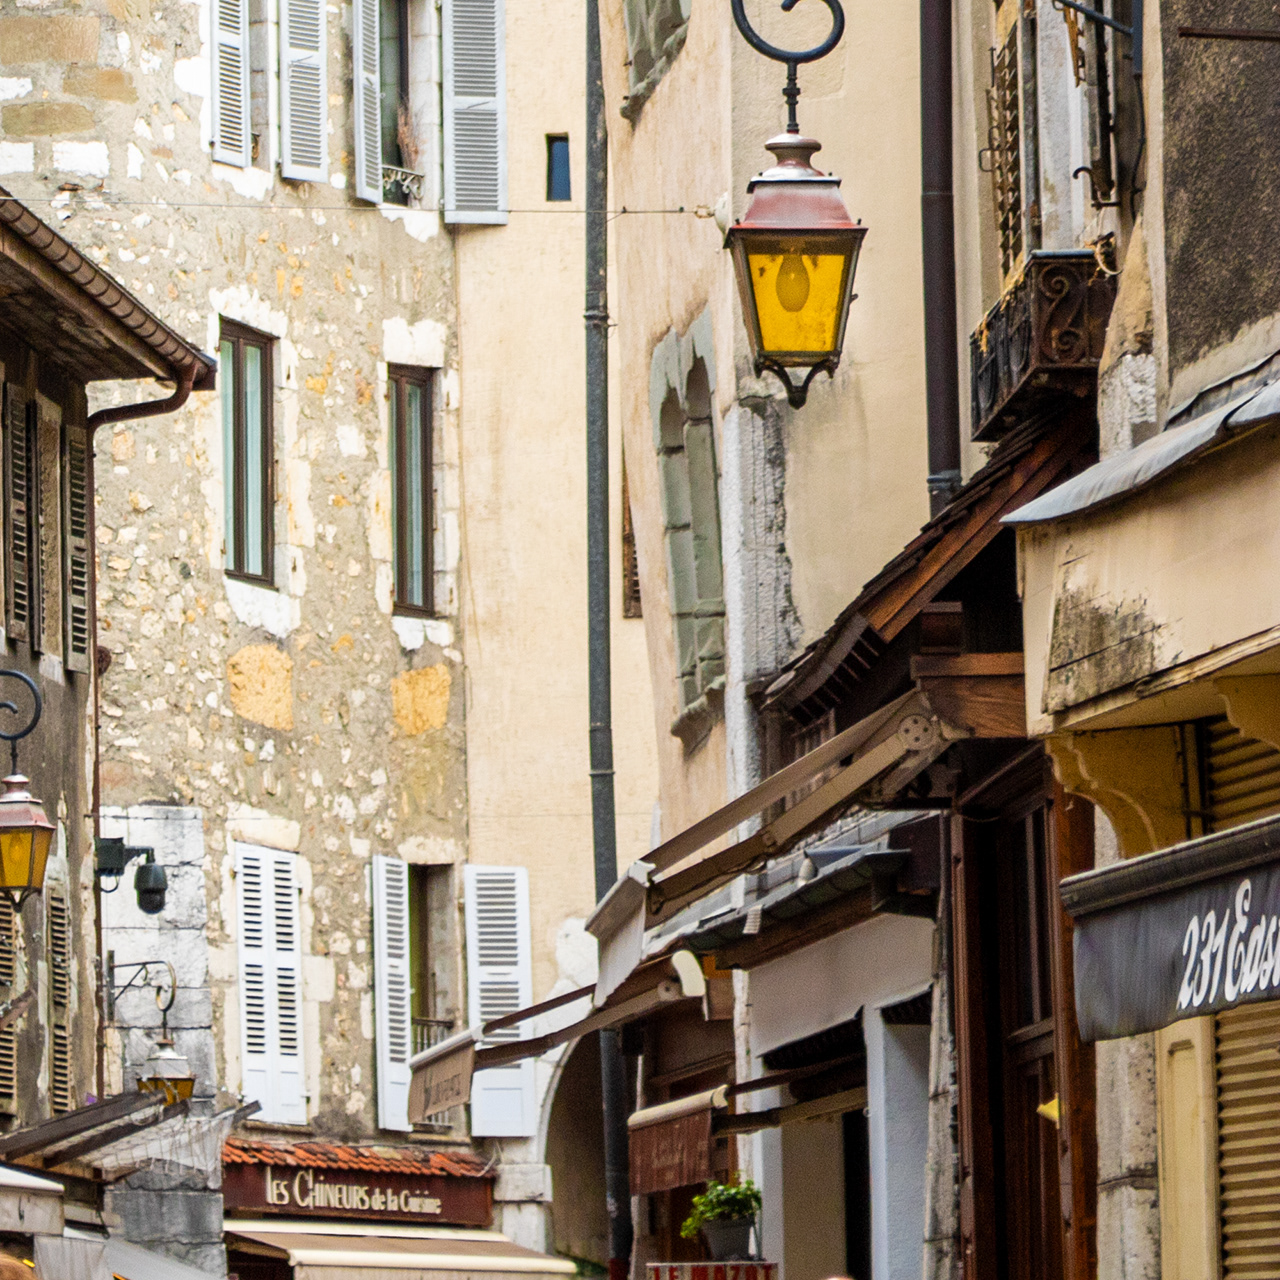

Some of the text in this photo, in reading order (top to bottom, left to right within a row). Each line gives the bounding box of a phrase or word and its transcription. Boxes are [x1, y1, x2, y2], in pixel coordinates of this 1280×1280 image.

[1176, 878, 1280, 1010] 231 Eas
[265, 1166, 290, 1205] LES
